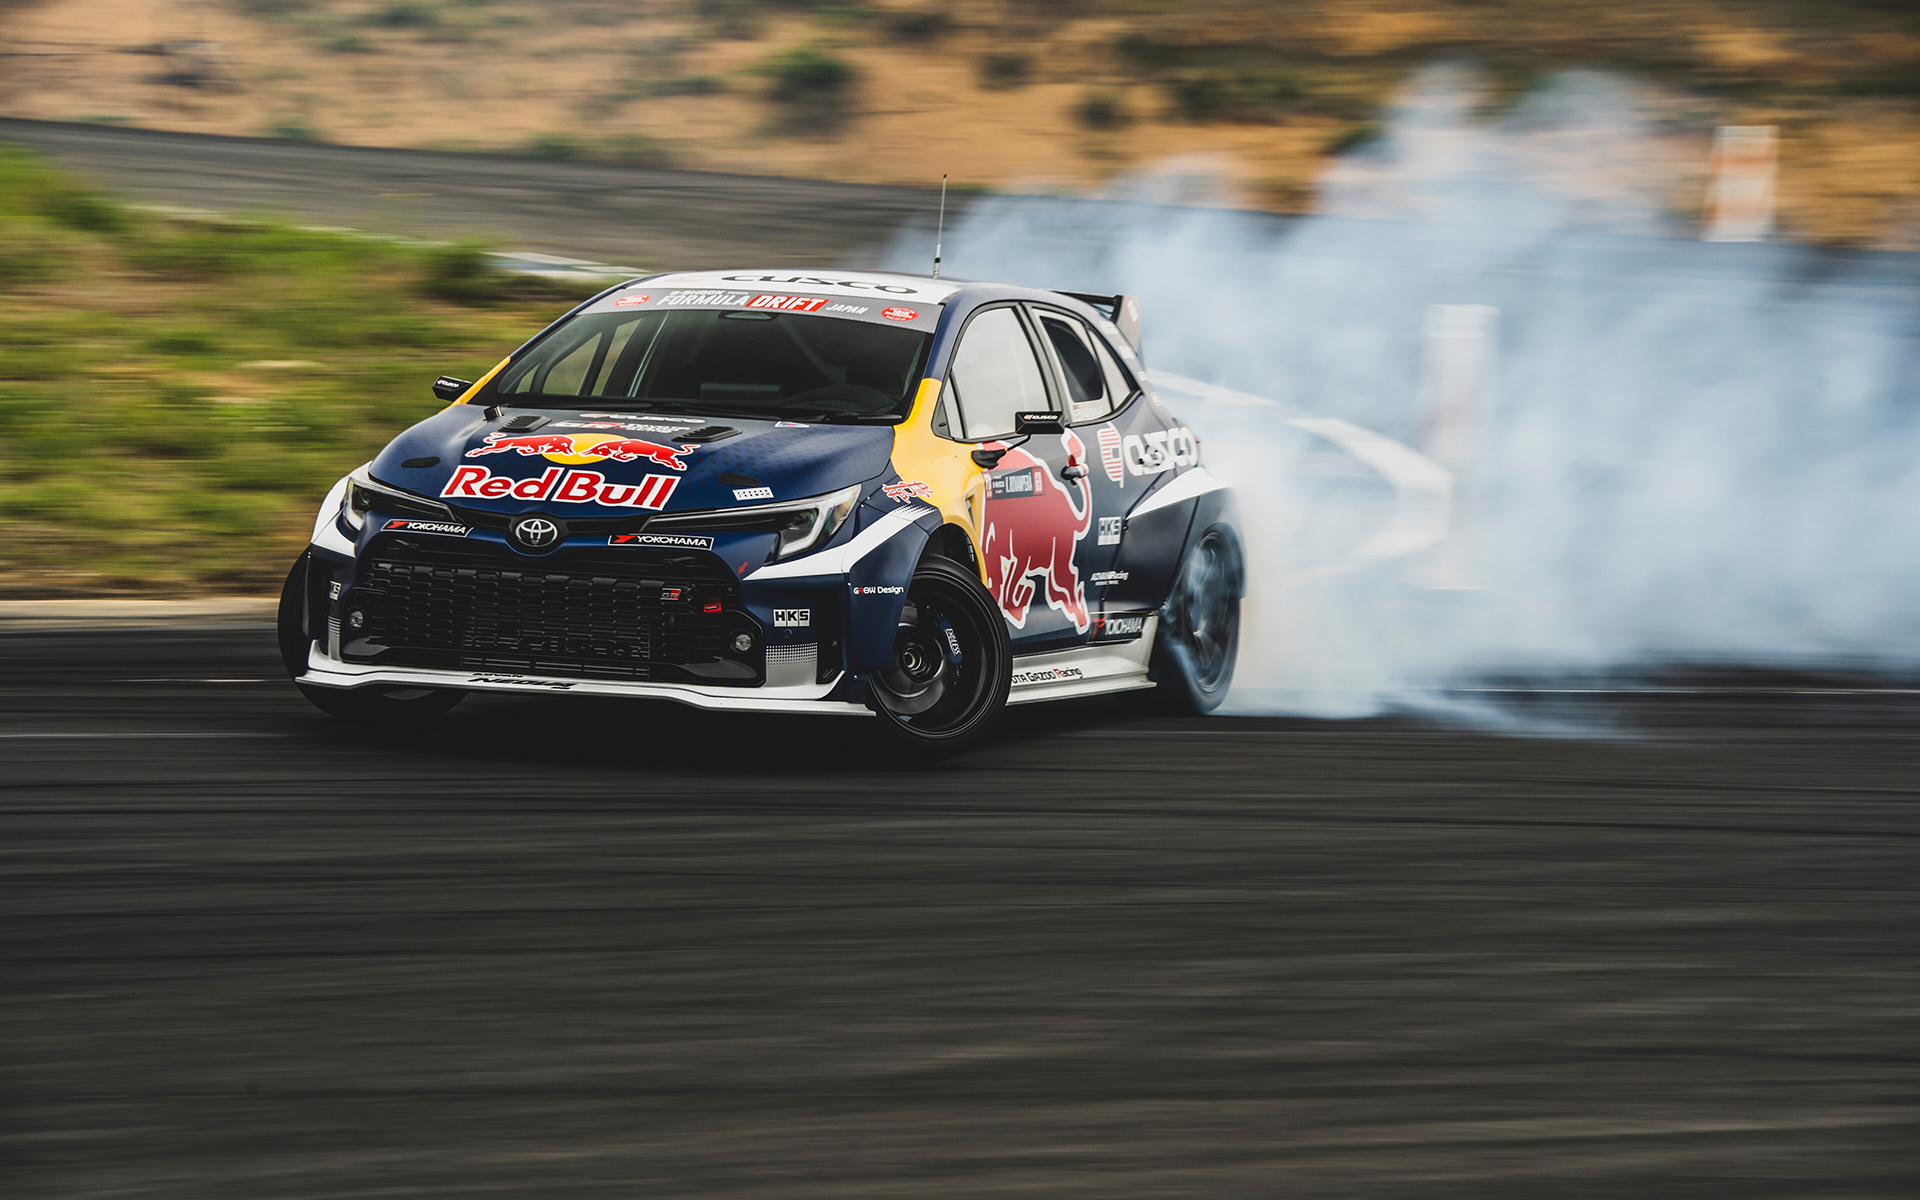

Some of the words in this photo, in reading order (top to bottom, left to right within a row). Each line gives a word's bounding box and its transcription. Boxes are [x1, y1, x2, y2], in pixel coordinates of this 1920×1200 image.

[721, 275, 919, 293] CUSCO
[656, 295, 751, 306] FORMULA
[750, 294, 825, 311] DRIFT
[825, 299, 869, 315] JAPAN
[441, 466, 563, 500] Red
[552, 470, 680, 509] Bull
[406, 521, 467, 534] YOKOHAMA
[636, 535, 709, 547] YOKOHAMA
[853, 587, 876, 595] GROW
[877, 586, 904, 595] Design
[774, 610, 809, 622] HKS
[1105, 618, 1142, 635] YOKOHAMA
[1026, 671, 1057, 682] GAZOO
[1053, 667, 1084, 680] Racing
